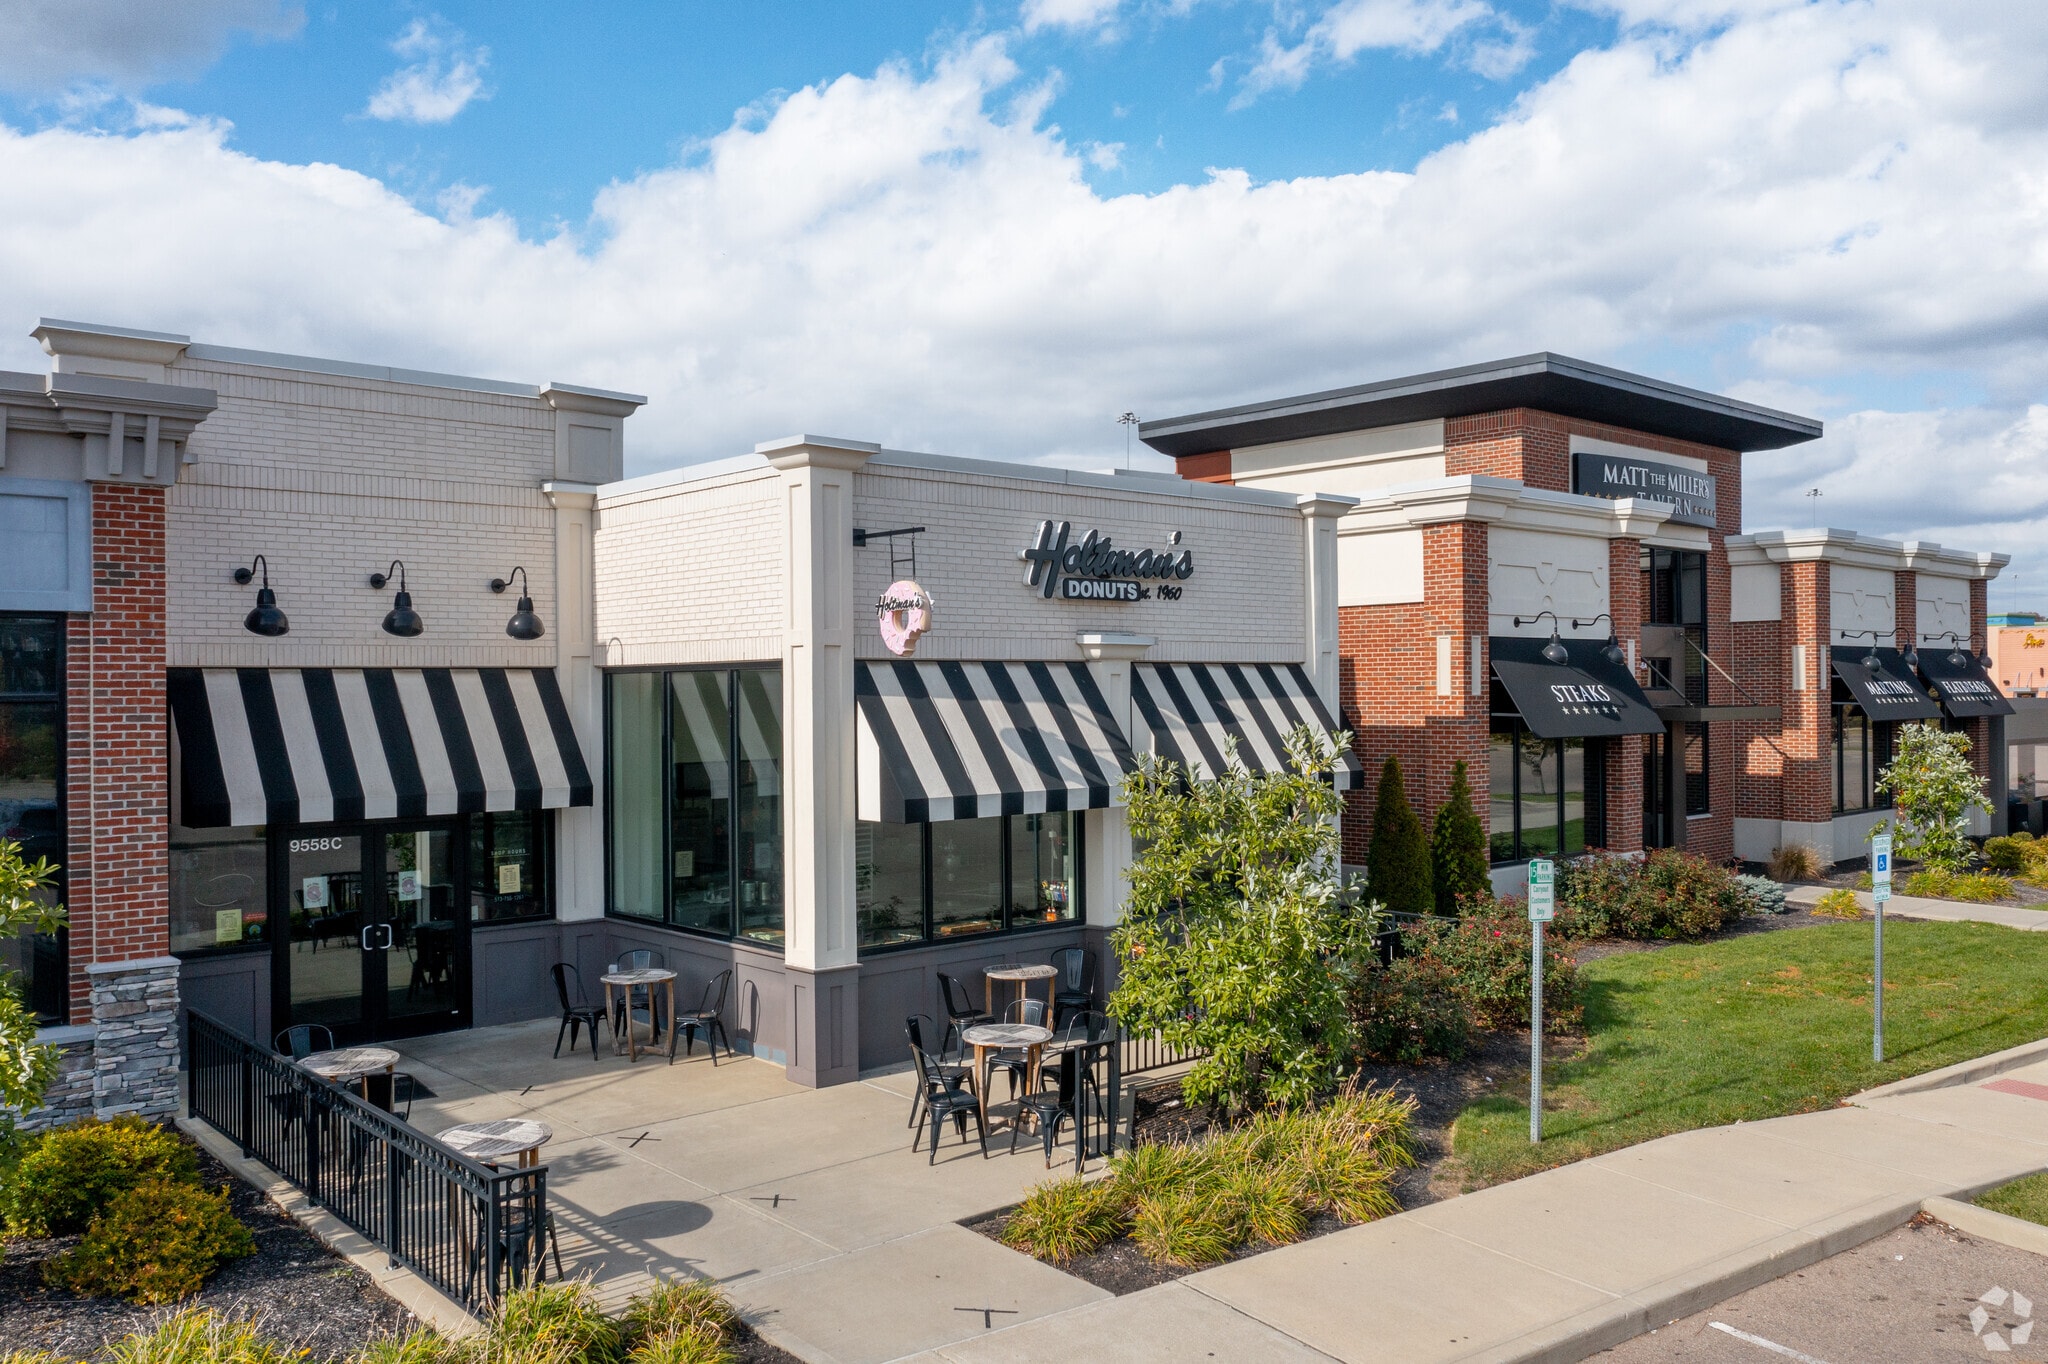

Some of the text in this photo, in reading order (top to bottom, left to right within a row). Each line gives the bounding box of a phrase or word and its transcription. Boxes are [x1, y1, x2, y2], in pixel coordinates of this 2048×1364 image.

[1602, 463, 1710, 499] MATT THE MILLER'S
[1019, 520, 1194, 599] Holtman's
[1068, 580, 1138, 600] DONUTS
[1157, 584, 1183, 601] 1960
[875, 592, 921, 619] Holtman's
[1550, 684, 1611, 703] STEAKS
[1864, 680, 1914, 695] MARTINIS
[1941, 680, 1992, 694] FLATBREADS
[1530, 866, 1537, 878] 15
[1537, 873, 1552, 881] PARKING
